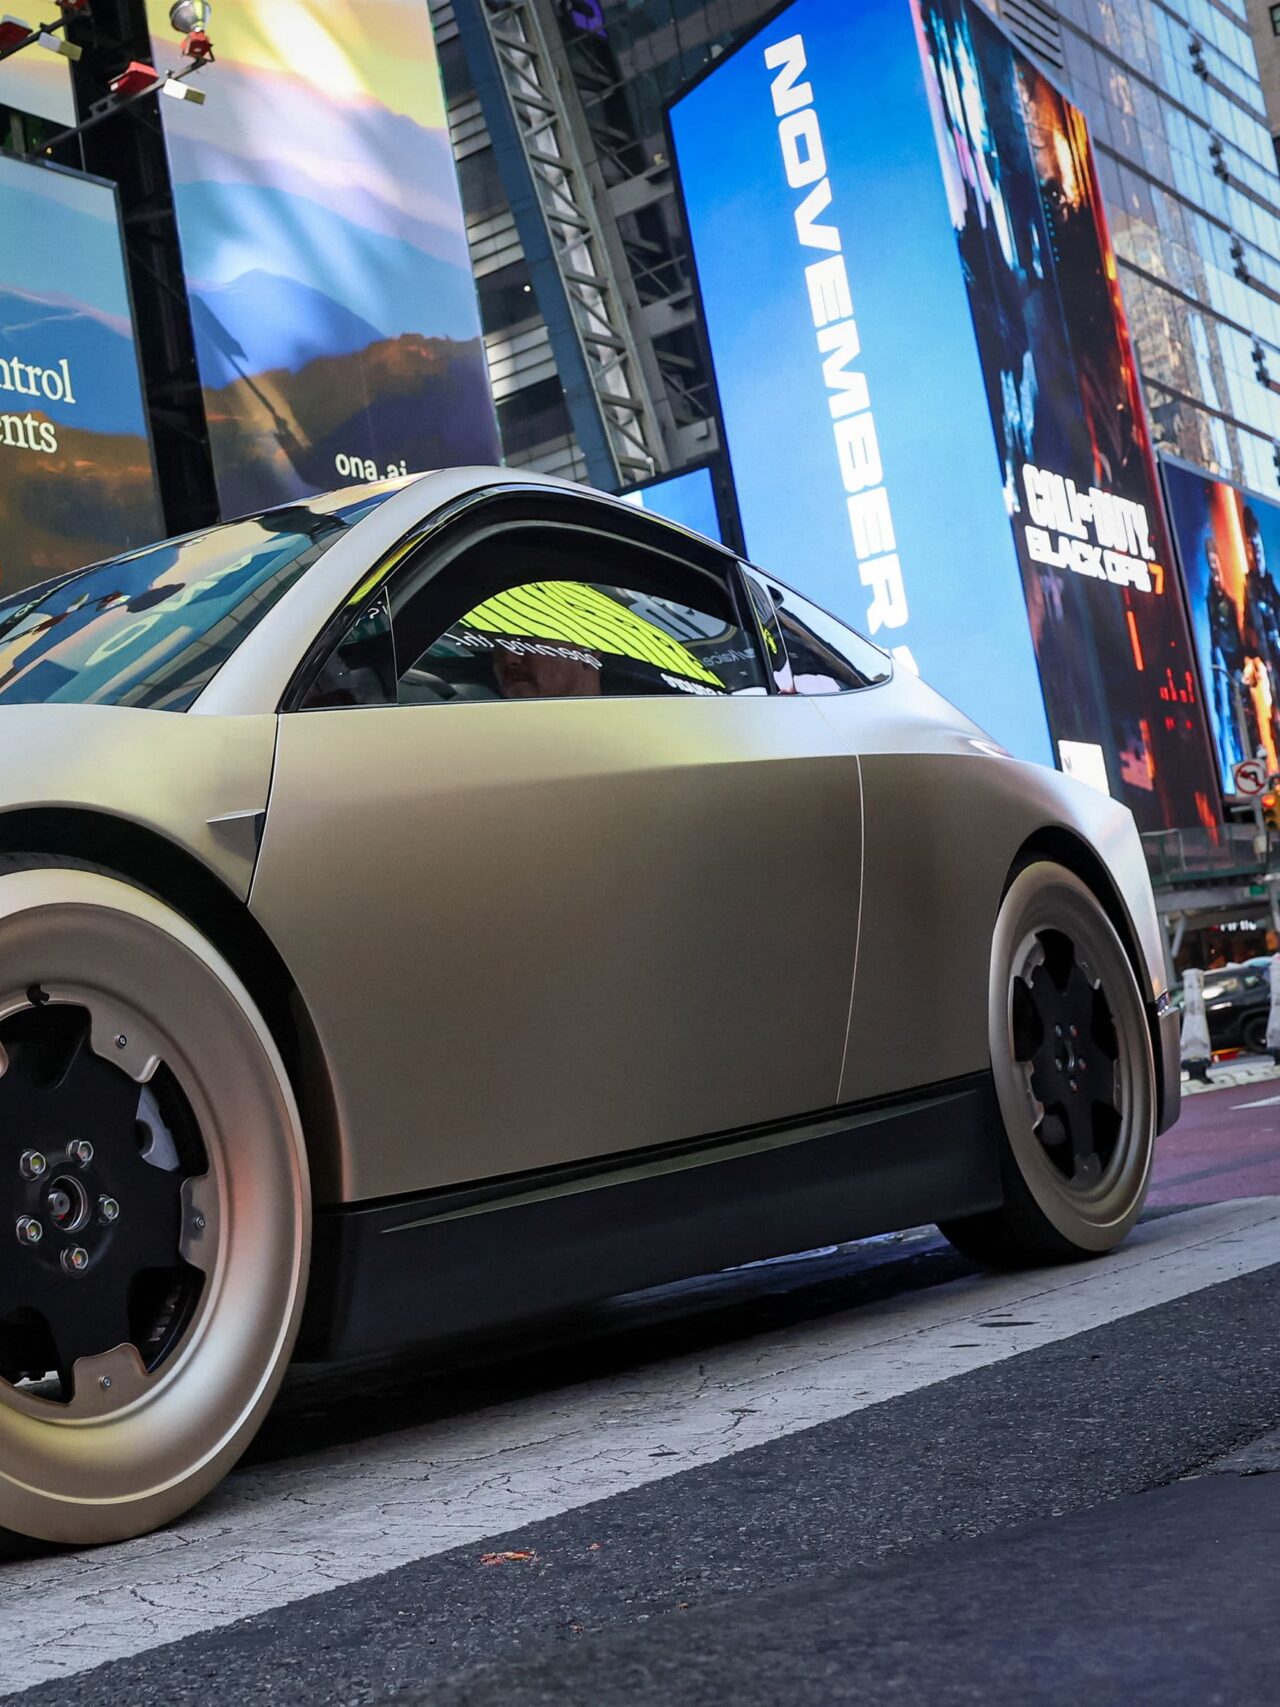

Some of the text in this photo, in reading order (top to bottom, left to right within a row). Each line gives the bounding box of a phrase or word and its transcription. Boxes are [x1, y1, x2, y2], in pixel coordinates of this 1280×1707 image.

[764, 33, 909, 636] NOVEMBER
[335, 453, 408, 481] ona.ai
[1022, 463, 1088, 540] CALL
[1025, 525, 1165, 595] BLACK OPS 7
